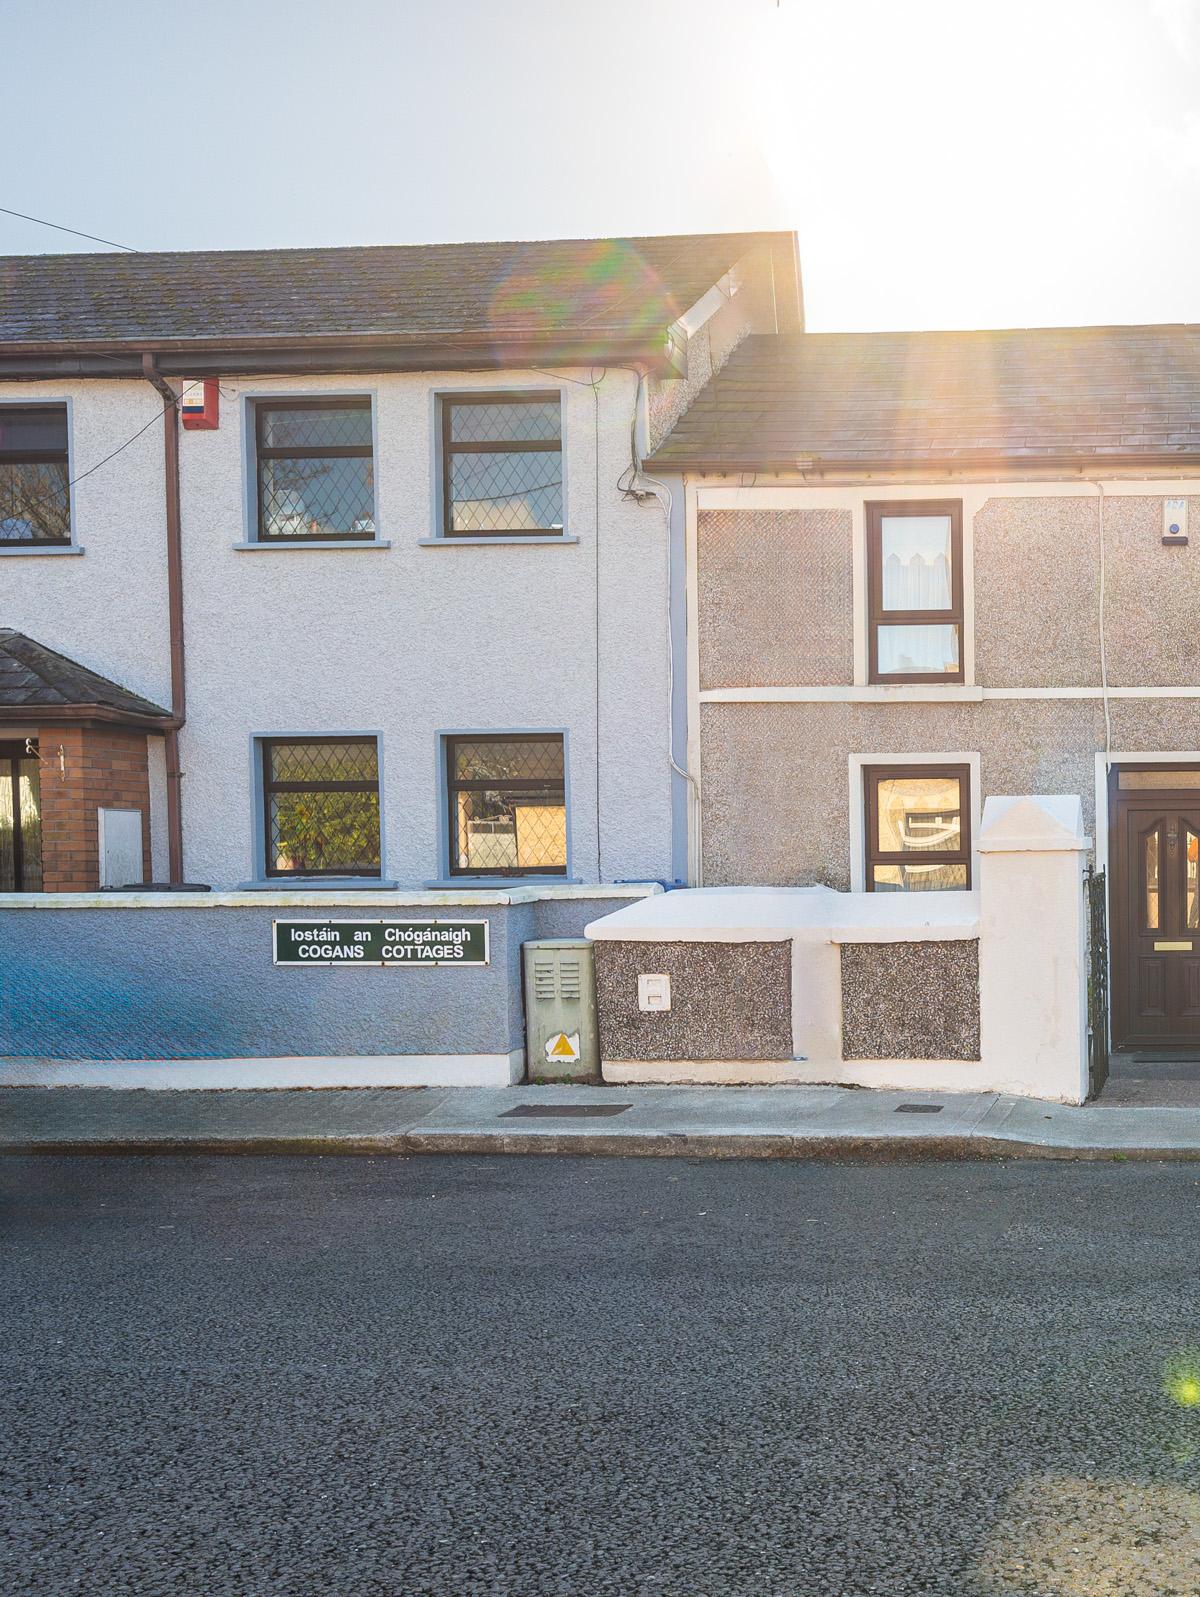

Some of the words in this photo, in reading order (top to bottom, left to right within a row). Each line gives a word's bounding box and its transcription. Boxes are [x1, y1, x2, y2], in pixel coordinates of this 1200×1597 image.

[290, 928, 340, 941] Iostáin
[353, 931, 372, 941] an
[384, 928, 471, 944] Chógánaigh
[298, 945, 364, 958] COGANS
[381, 945, 464, 958] COTTAGES
